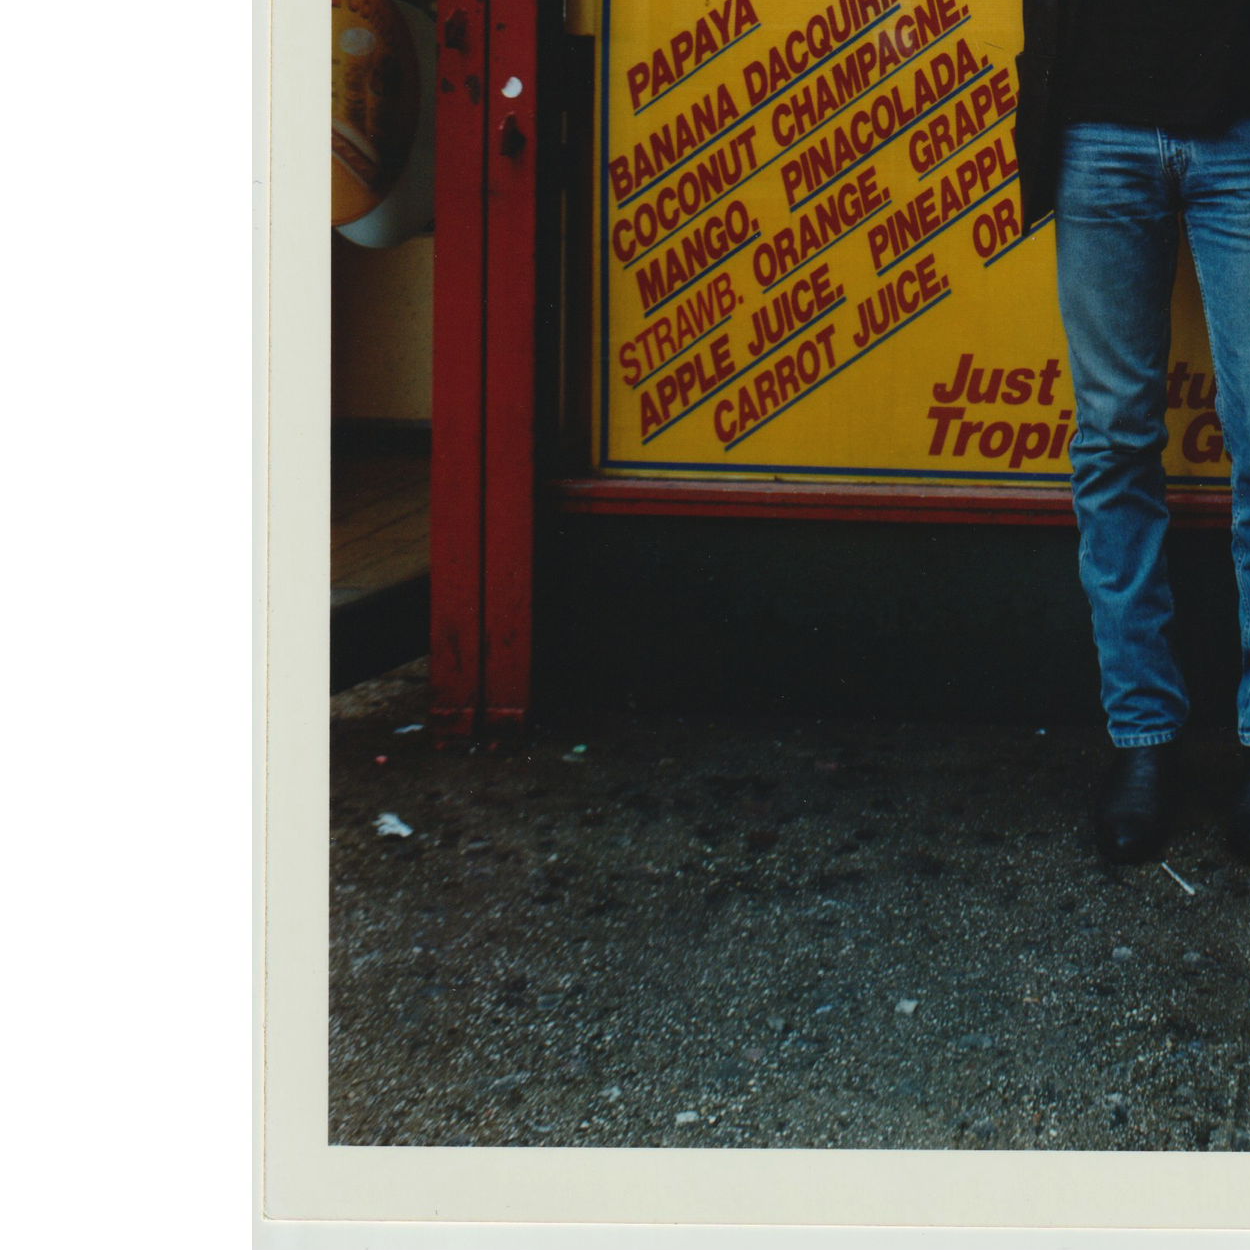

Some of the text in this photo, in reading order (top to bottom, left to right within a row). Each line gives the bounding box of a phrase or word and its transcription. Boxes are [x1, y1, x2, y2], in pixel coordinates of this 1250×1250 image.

[609, 83, 740, 203] BANANA
[612, 126, 760, 264] COCONUT
[635, 38, 989, 311] MANGO. PINACOLADA.
[619, 272, 744, 388] STRAWB.
[752, 166, 893, 288] ORANGE.
[640, 127, 1019, 438] APPLE JUICE. PINEAPPL
[714, 325, 838, 444] CARROT
[853, 254, 950, 348] JUICE.
[927, 406, 1078, 469] Tropi
[932, 353, 1062, 406] Just
